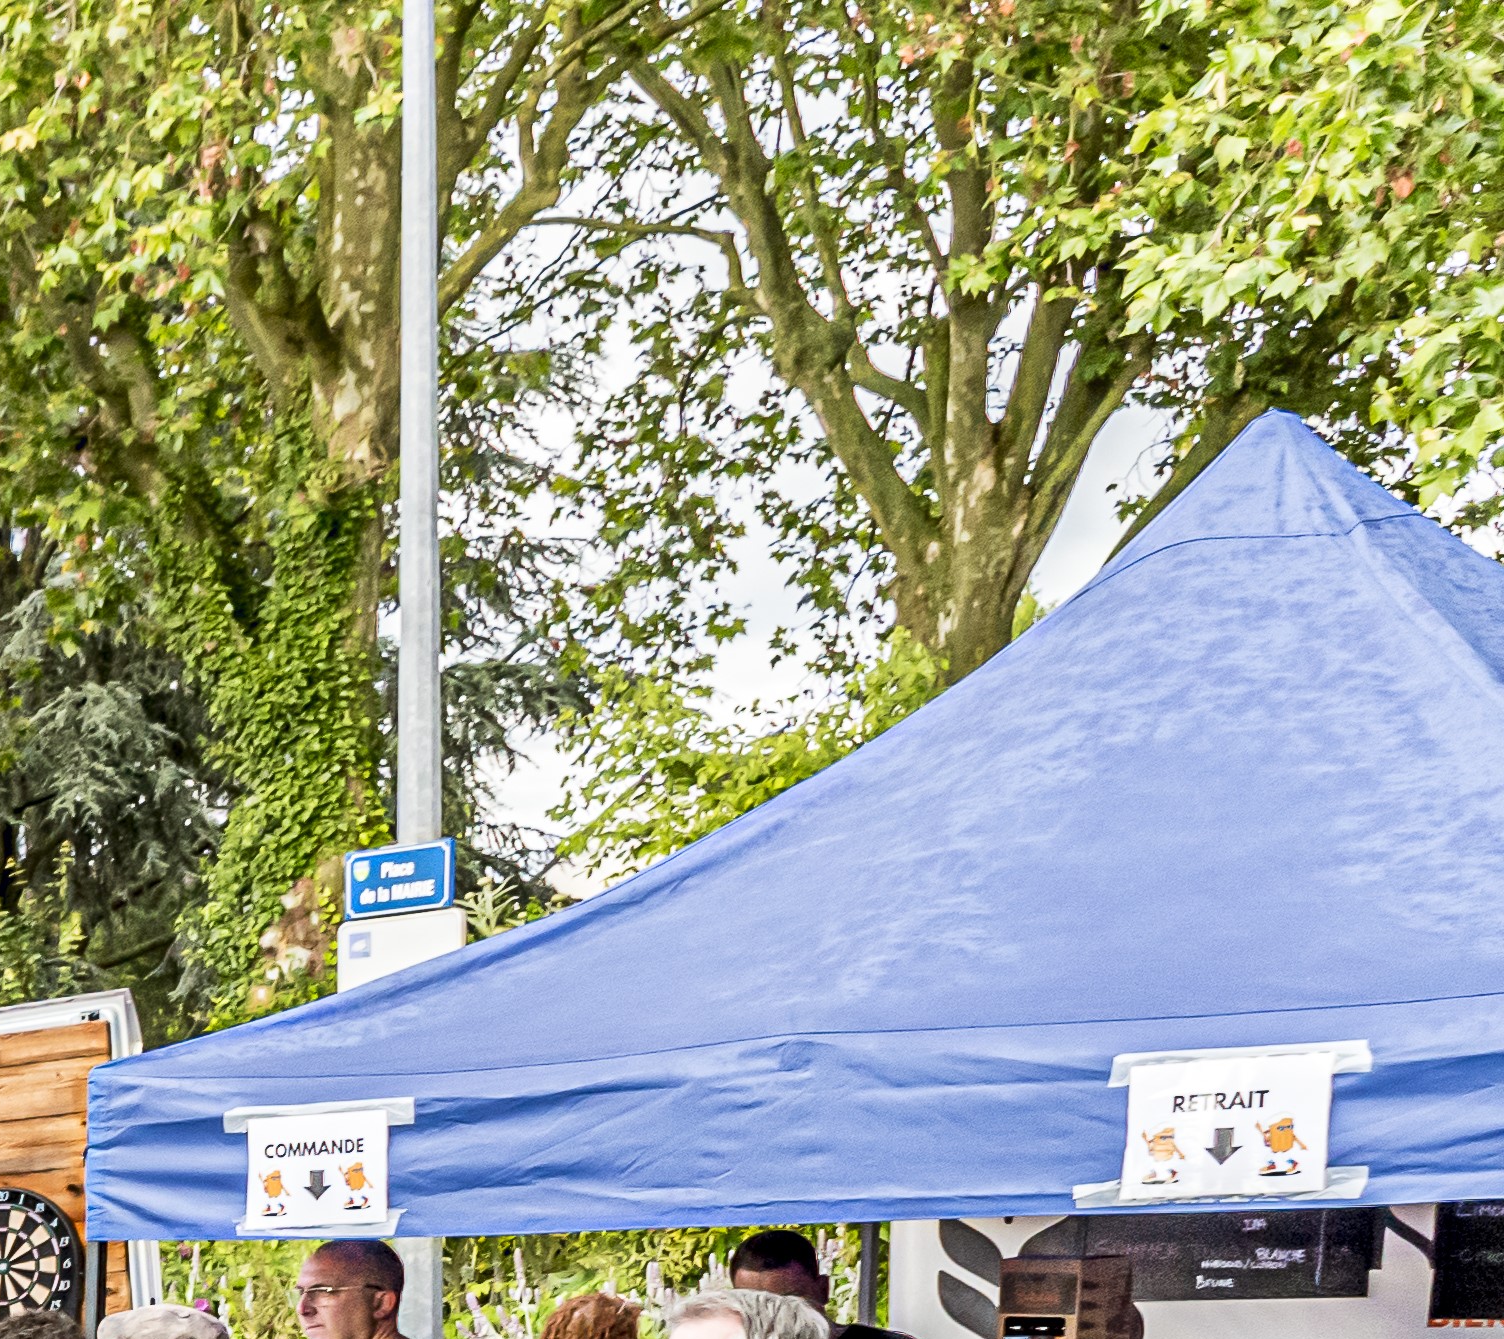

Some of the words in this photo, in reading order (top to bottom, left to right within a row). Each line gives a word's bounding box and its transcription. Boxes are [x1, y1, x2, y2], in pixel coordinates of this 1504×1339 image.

[380, 861, 415, 879] Place
[359, 888, 376, 905] de
[377, 886, 390, 902] la
[391, 879, 436, 901] MAIRIE
[1172, 1089, 1270, 1113] RETRAIT
[264, 1137, 365, 1159] COMMANDE
[18, 1193, 25, 1205] 1
[59, 1236, 70, 1247] 13
[62, 1258, 72, 1269] 6
[58, 1279, 71, 1291] 10
